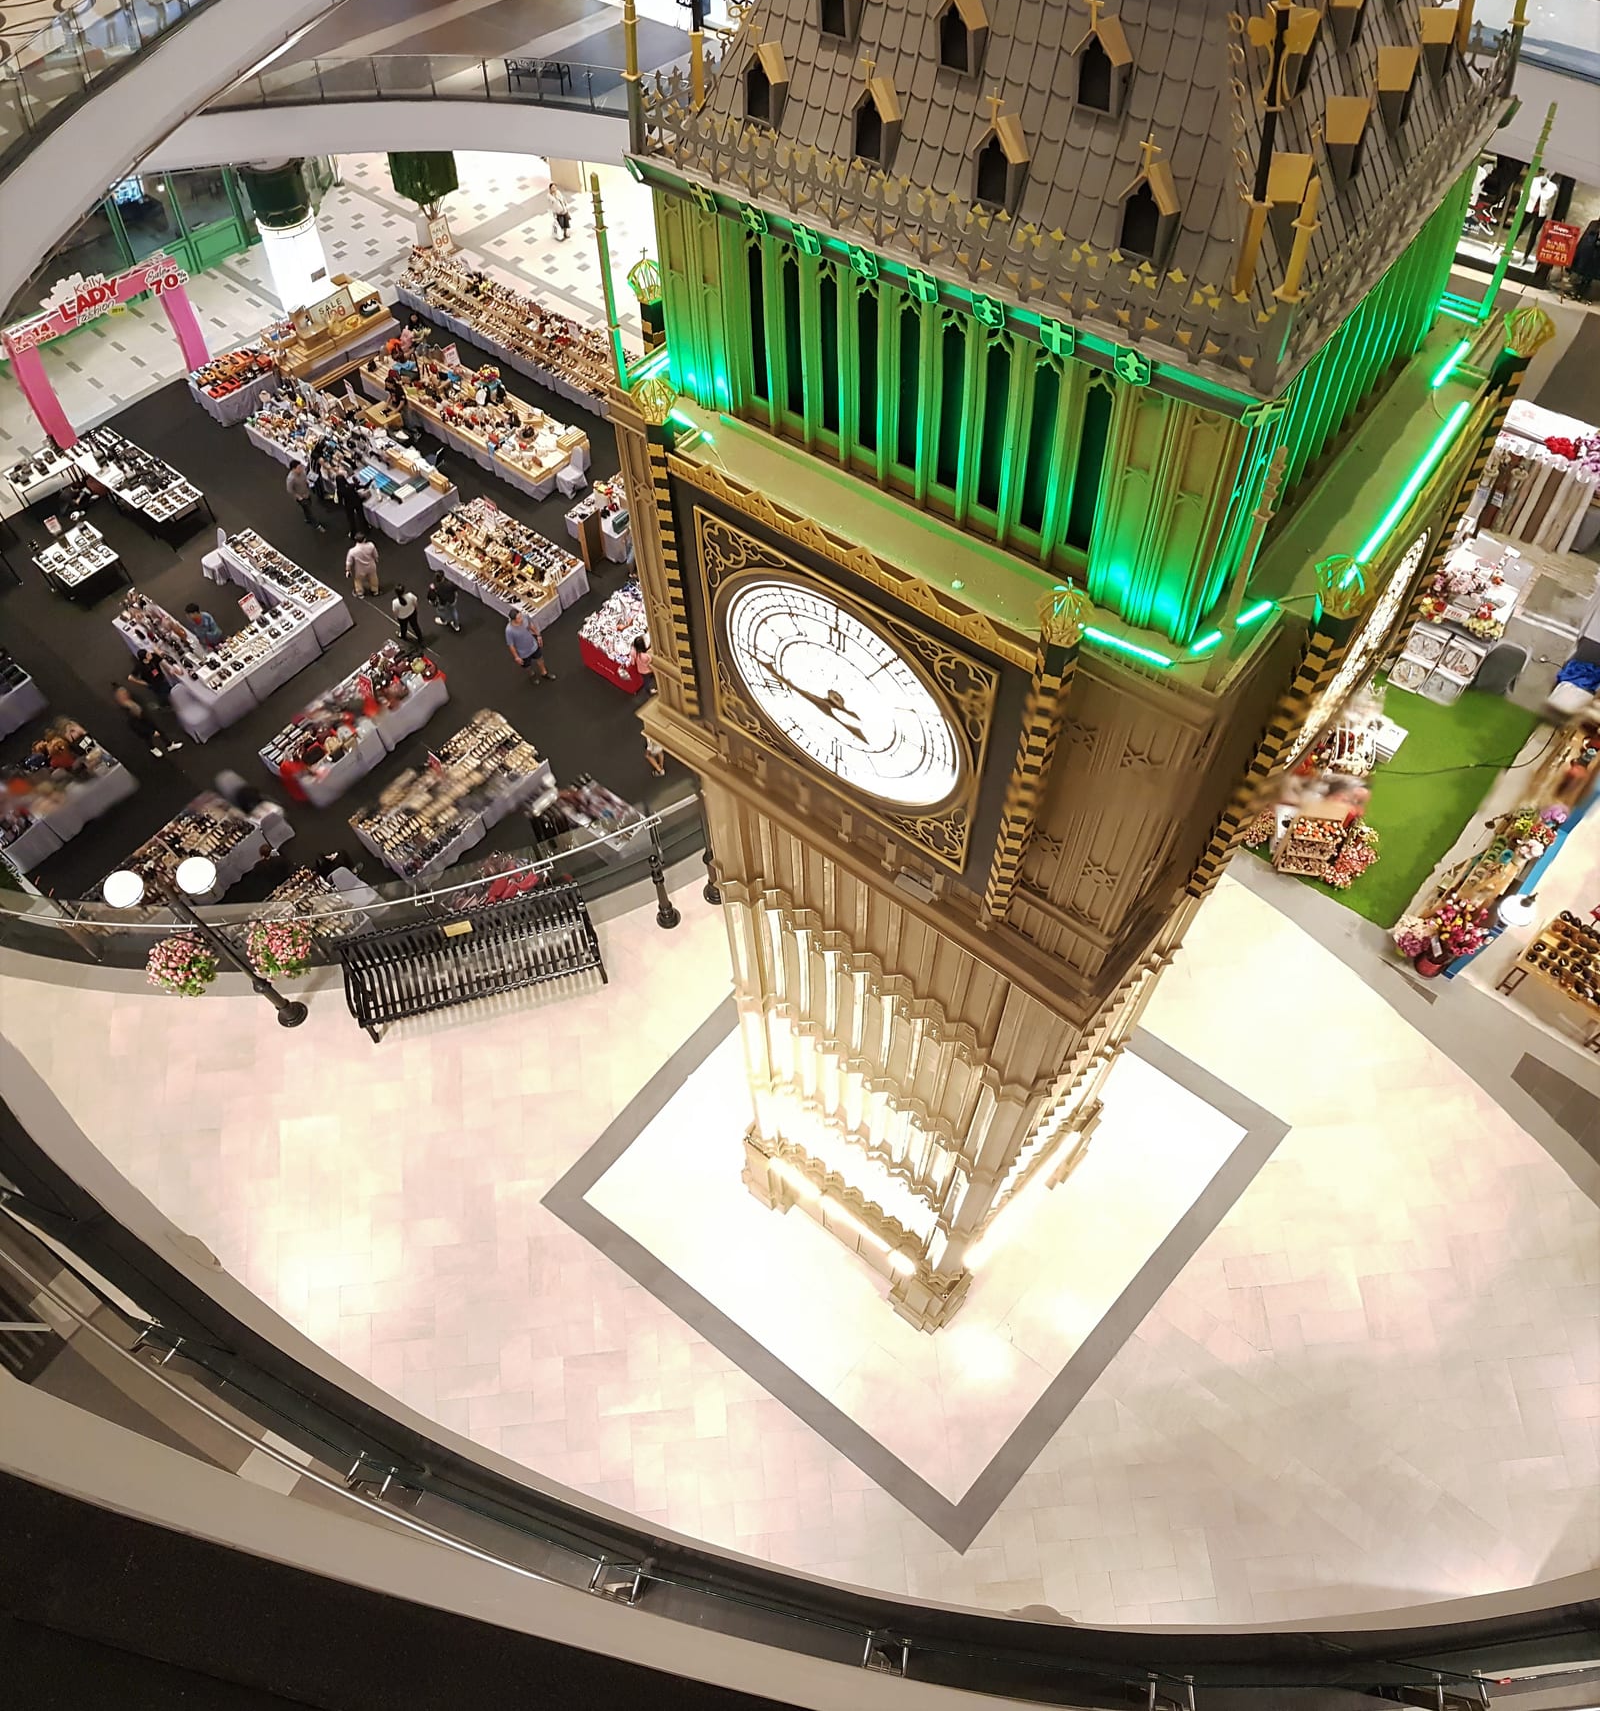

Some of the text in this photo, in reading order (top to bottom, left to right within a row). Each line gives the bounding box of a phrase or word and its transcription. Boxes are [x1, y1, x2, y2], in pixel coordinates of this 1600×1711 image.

[73, 276, 102, 294] Kelly
[58, 278, 119, 321] LADY
[318, 297, 343, 315] SALE
